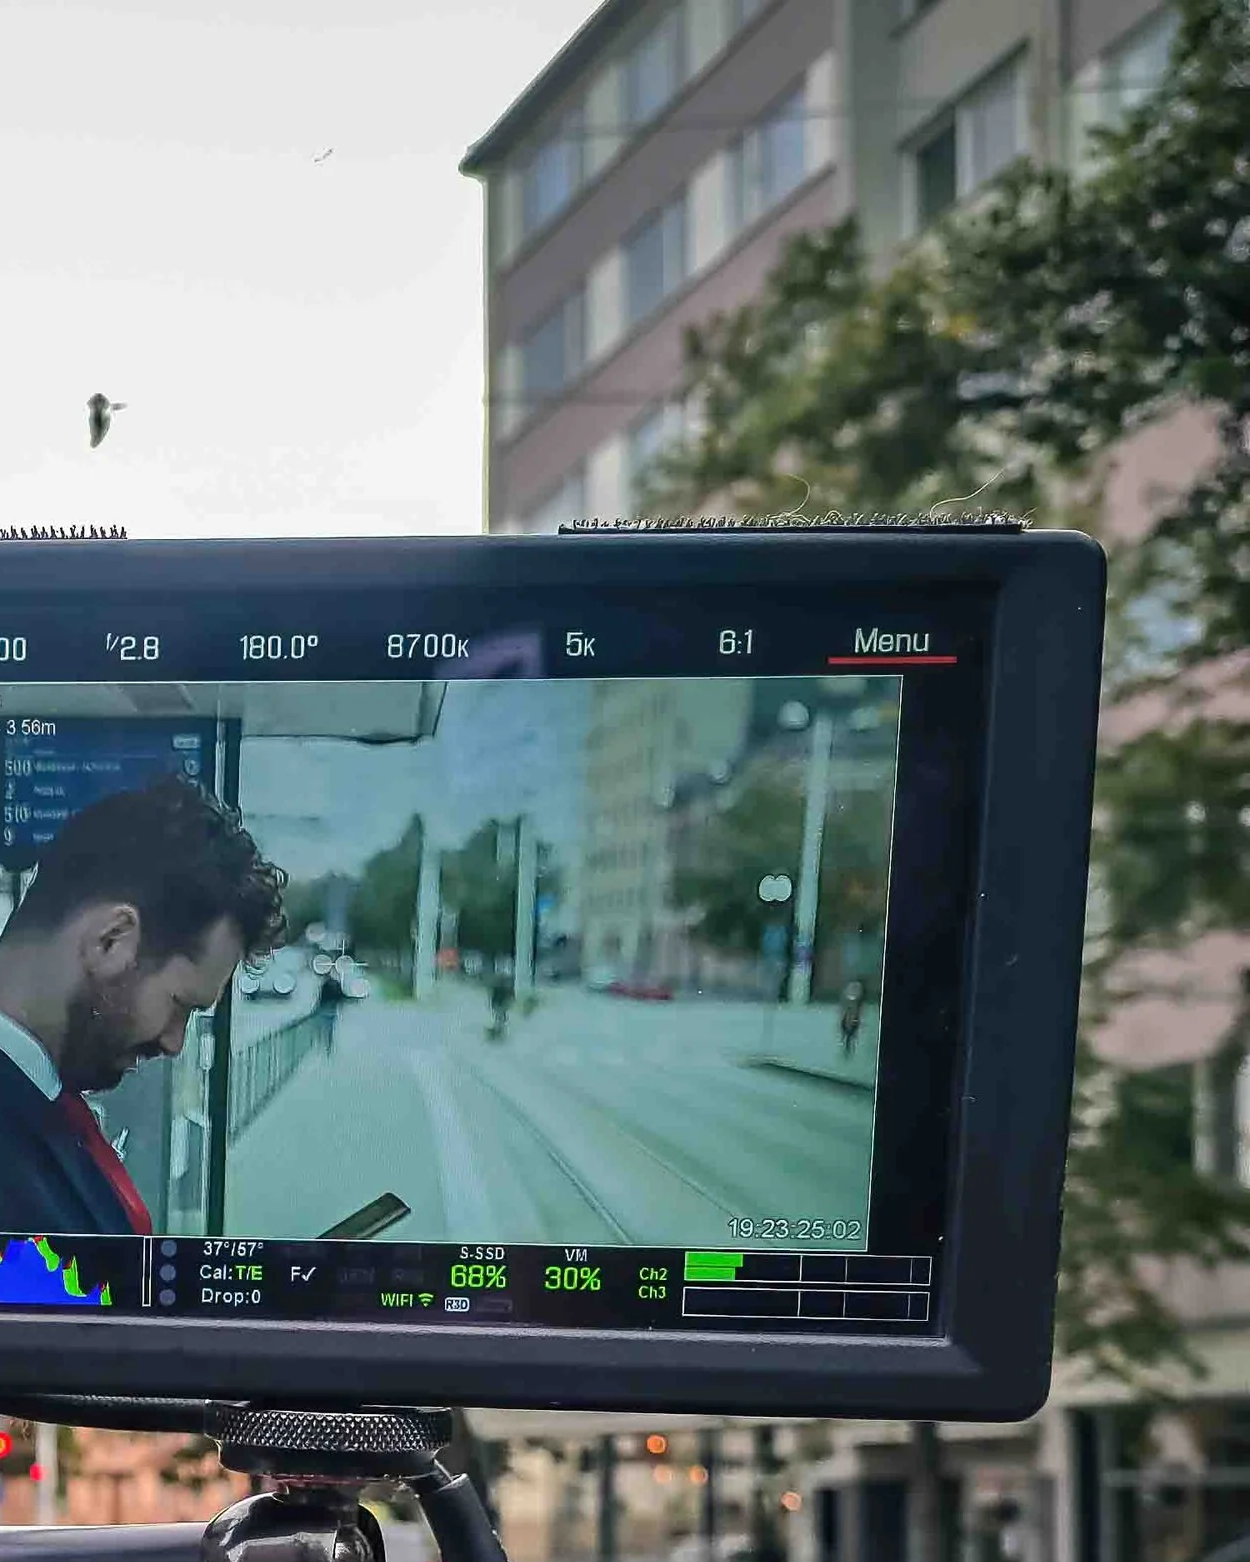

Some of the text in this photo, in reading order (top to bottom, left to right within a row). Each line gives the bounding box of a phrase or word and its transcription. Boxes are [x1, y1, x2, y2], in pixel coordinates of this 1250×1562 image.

[106, 632, 160, 661] f/2.8
[239, 633, 320, 660] 180.0°
[386, 632, 470, 659] 8700K
[565, 631, 596, 657] 5K
[718, 628, 755, 656] 6:1
[853, 627, 930, 655] Menu
[728, 1217, 861, 1241] 19:23:25:02
[459, 1246, 505, 1261] S-SSD
[564, 1248, 587, 1262] VM
[451, 1264, 507, 1289] 68%
[544, 1266, 601, 1291] 30%
[639, 1267, 668, 1281] Ch2
[381, 1293, 414, 1308] WIFI
[638, 1285, 667, 1299] Ch3
